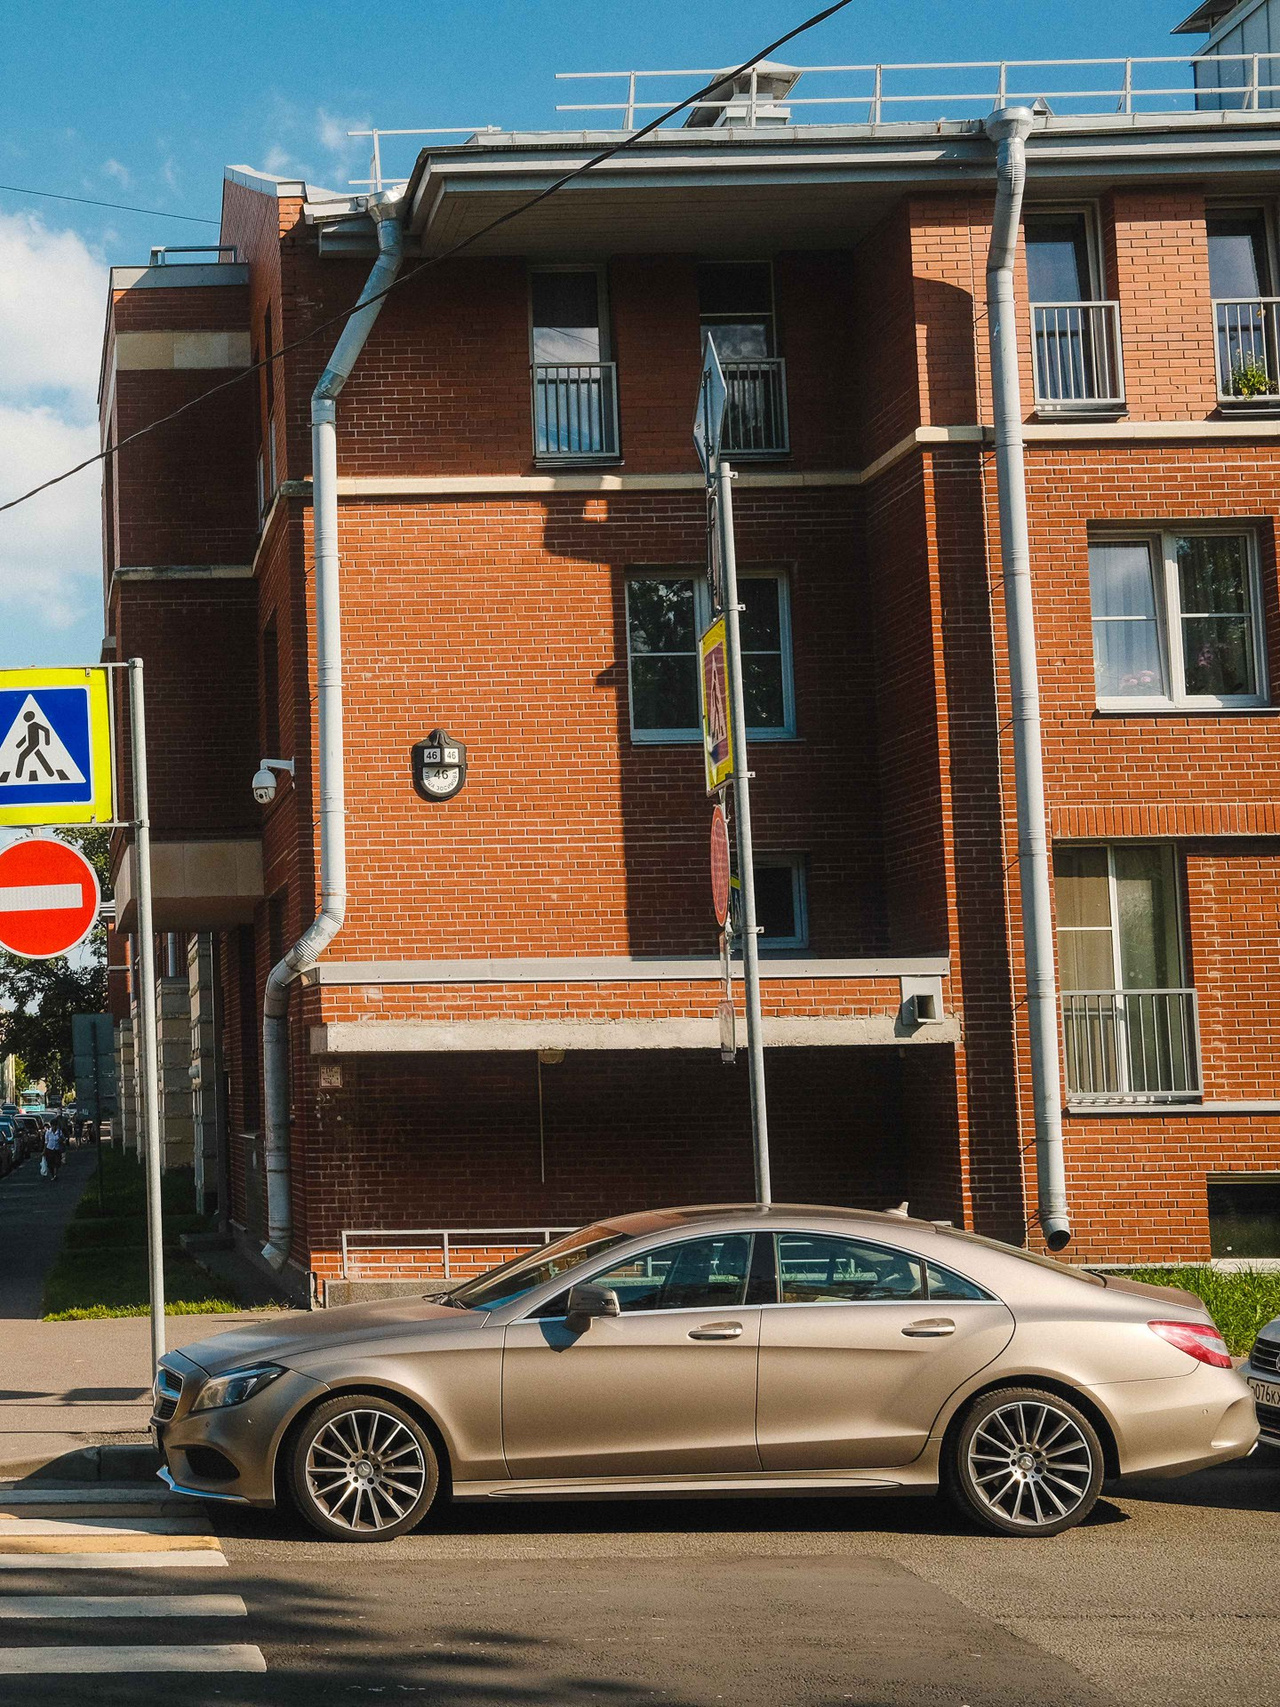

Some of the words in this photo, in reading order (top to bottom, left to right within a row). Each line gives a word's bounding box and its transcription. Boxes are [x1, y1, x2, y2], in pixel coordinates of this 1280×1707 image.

[426, 751, 438, 760] 46
[446, 751, 457, 760] 46
[433, 769, 449, 780] 46
